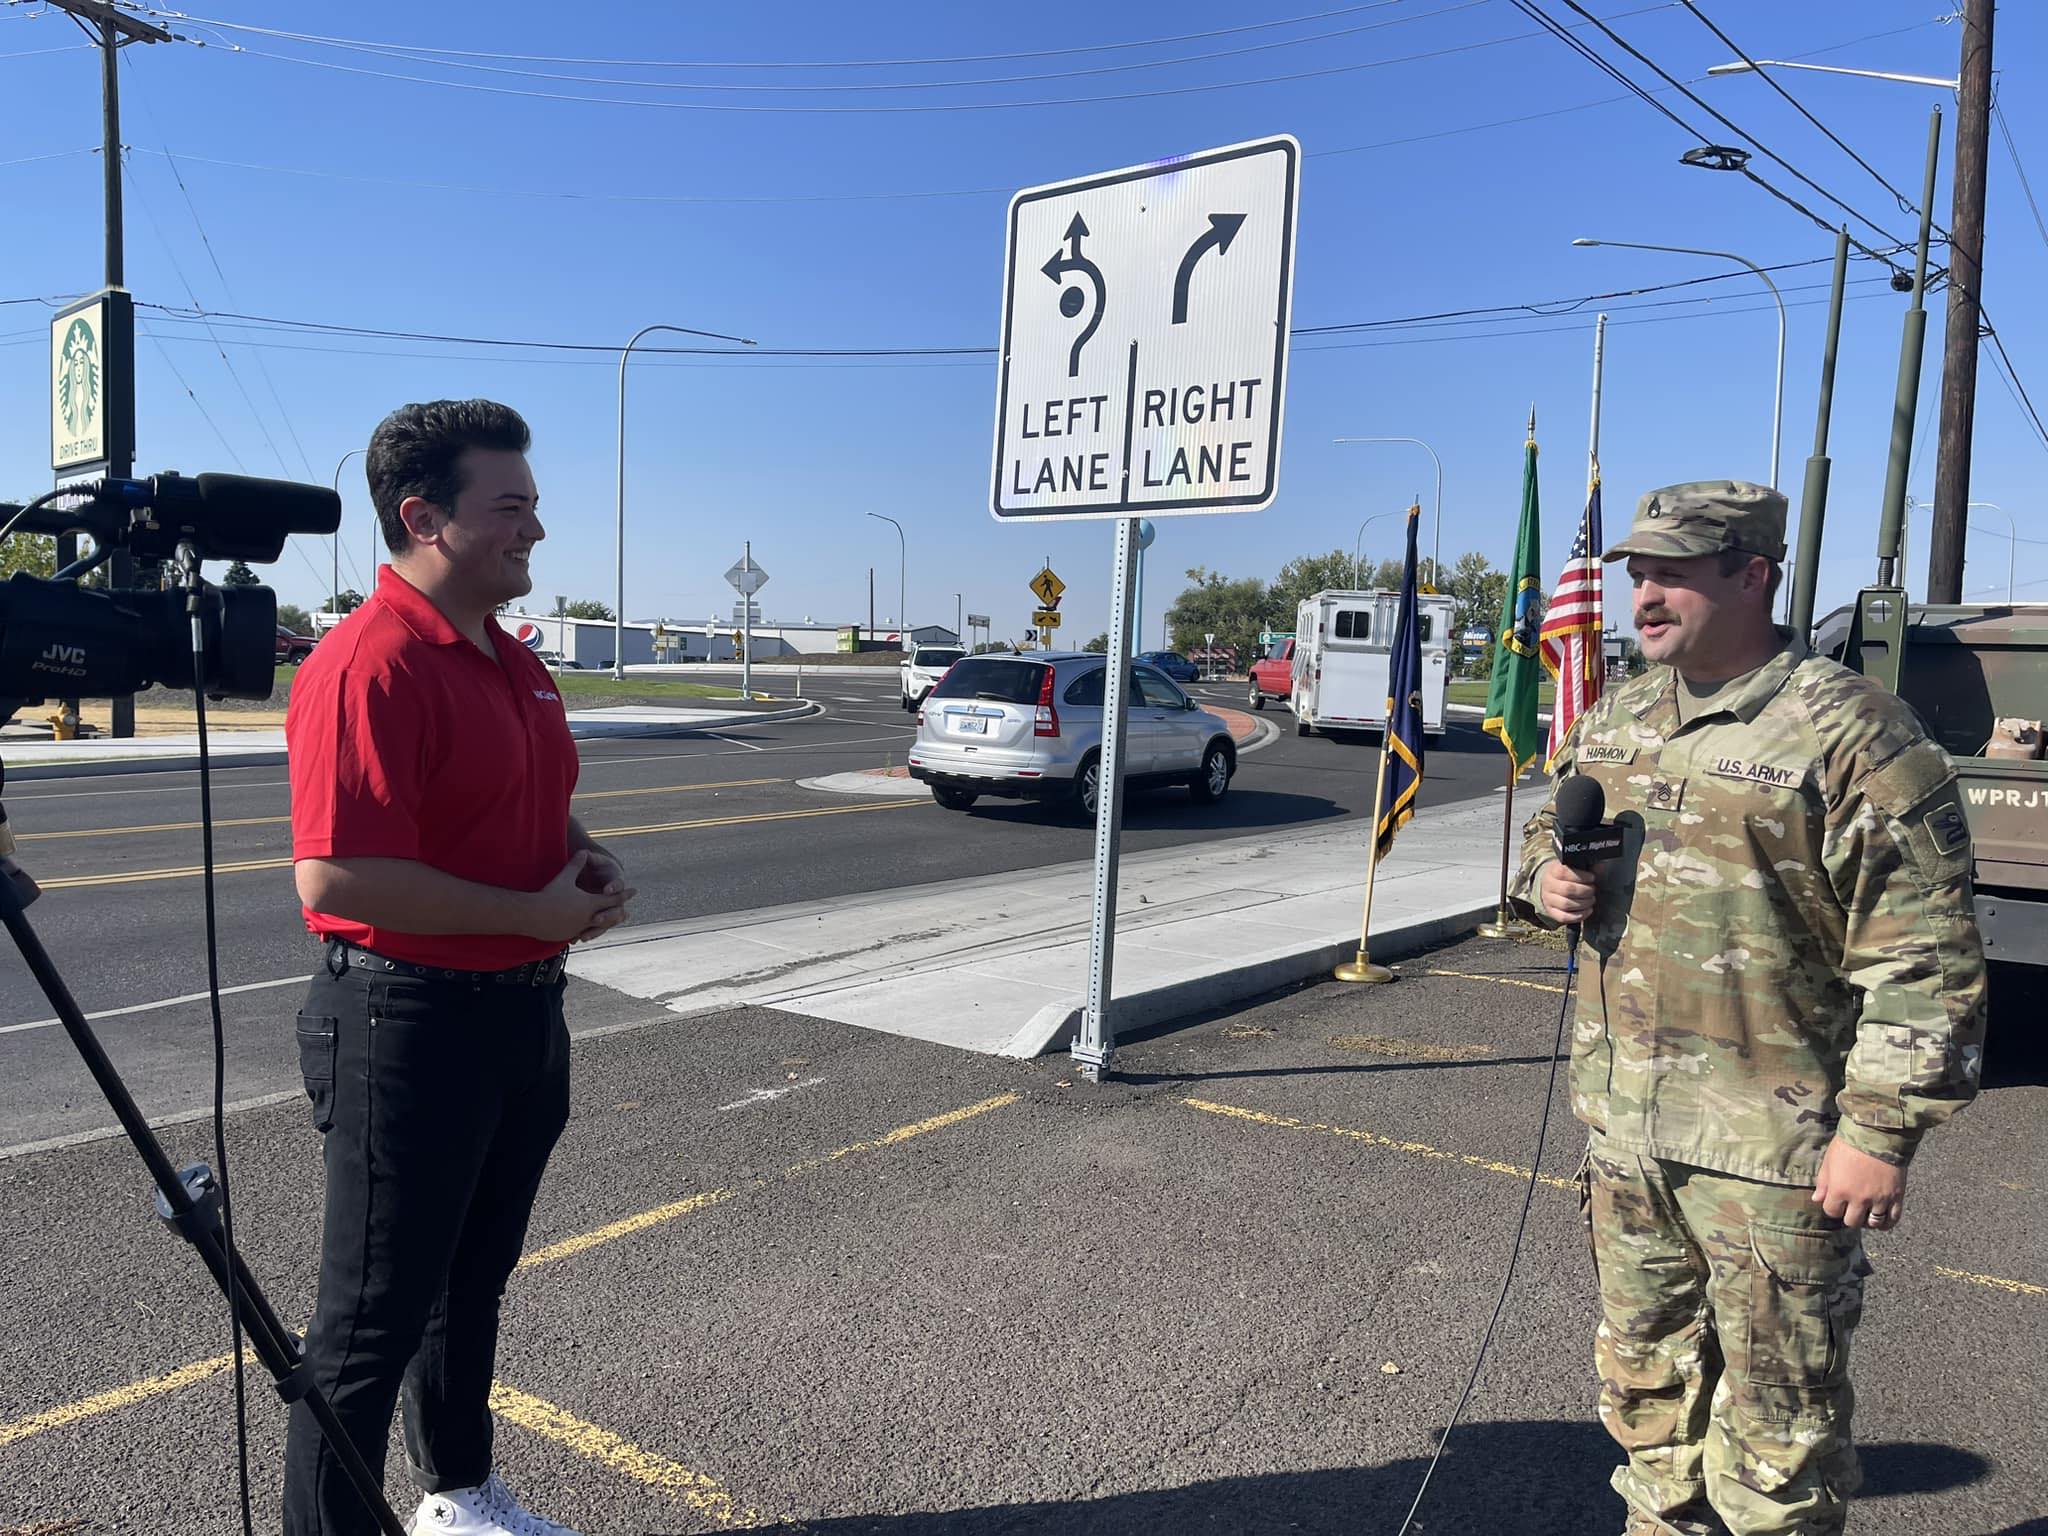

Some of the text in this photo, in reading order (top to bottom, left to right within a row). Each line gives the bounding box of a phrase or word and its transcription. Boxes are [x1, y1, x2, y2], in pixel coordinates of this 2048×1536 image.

[1143, 379, 1262, 428] RIGHT
[1022, 395, 1108, 439] LEFT
[59, 436, 98, 460] DRIVE THRU
[1013, 453, 1109, 495] LANE
[1143, 442, 1253, 488] LANE
[42, 643, 86, 664] JVC
[32, 661, 88, 677] ProHD
[1586, 747, 1627, 760] HARMON
[1717, 758, 1795, 784] U.S. ARMY
[1564, 843, 1581, 853] NBC
